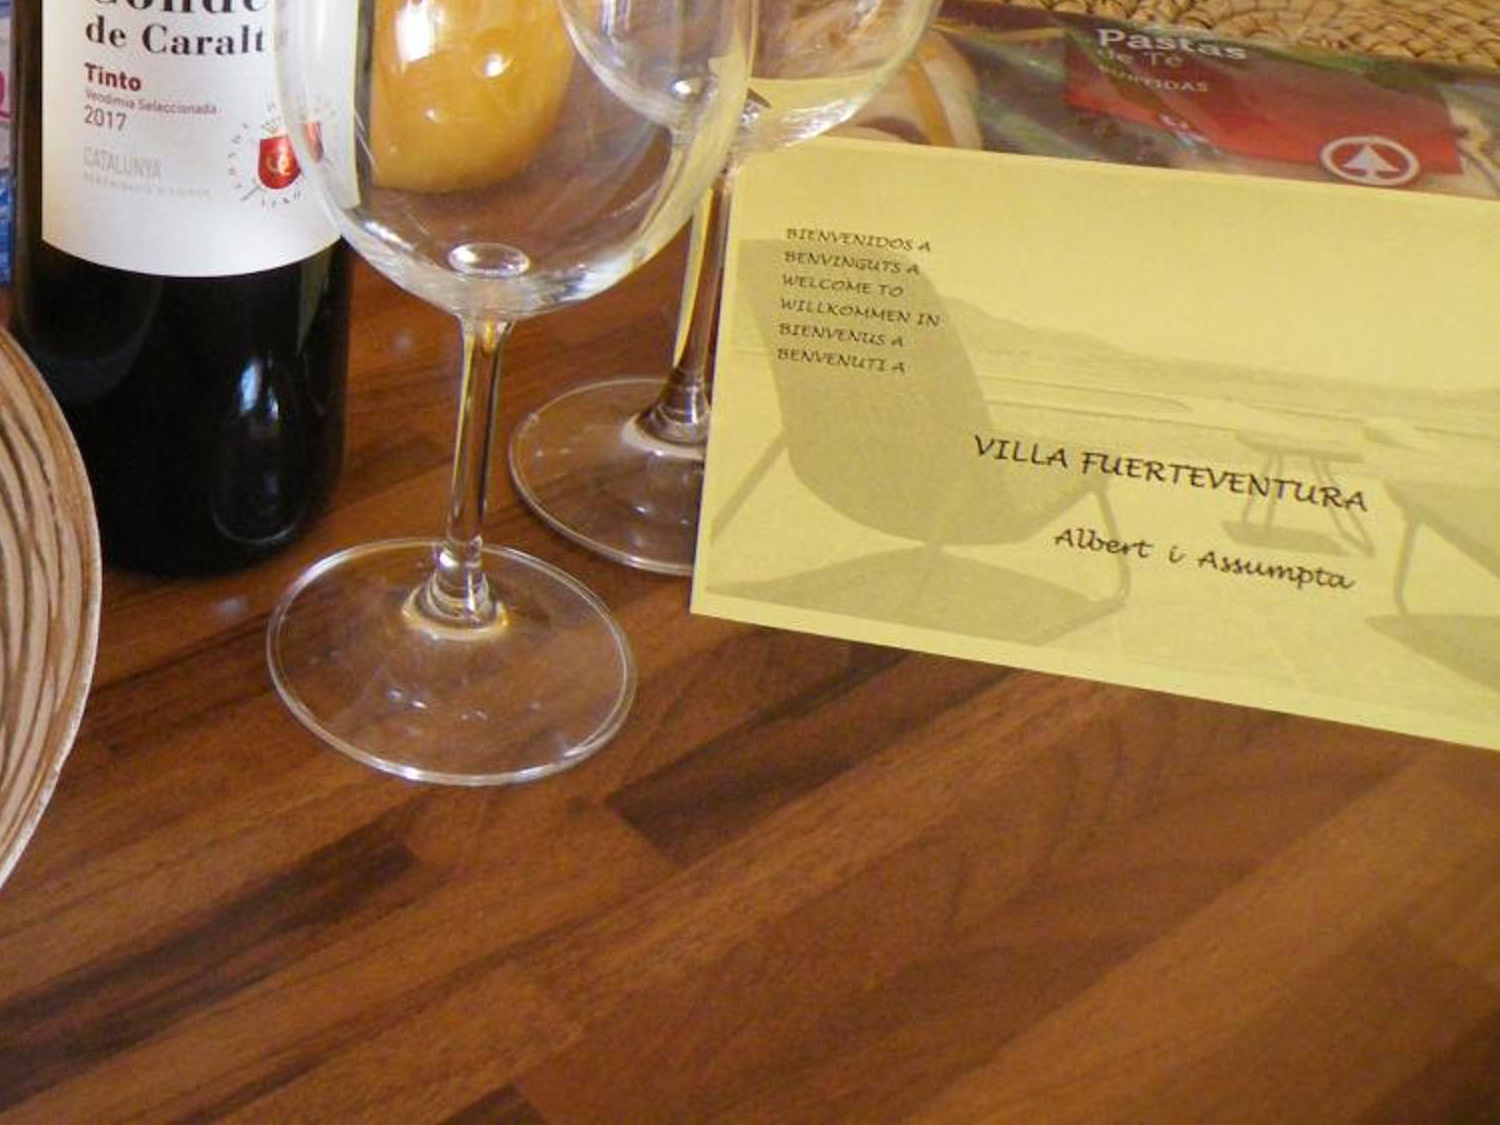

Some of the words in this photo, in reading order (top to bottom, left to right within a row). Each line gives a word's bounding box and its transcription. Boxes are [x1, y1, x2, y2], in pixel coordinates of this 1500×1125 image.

[85, 14, 127, 48] de
[141, 22, 266, 56] Caralt
[1096, 27, 1248, 61] Pastas
[84, 62, 143, 92] Tinto
[83, 104, 128, 132] 2017
[785, 227, 915, 252] BIENVENIDOS
[918, 239, 932, 252] A
[783, 249, 901, 274] BENVINGUTS
[906, 262, 921, 276] A
[781, 272, 874, 296] WELCOME
[878, 283, 905, 299] TO
[779, 296, 912, 324] WILLKOMMEN
[915, 311, 941, 328] IN
[778, 322, 886, 347] BIENVENUS
[890, 334, 905, 349] A
[776, 347, 888, 373] BENVENUTI
[890, 359, 906, 374] A
[974, 434, 1069, 469] VILLA
[1081, 451, 1368, 513] FUERTEVENTURA
[1053, 527, 1153, 558] Albert
[1168, 545, 1186, 564] i
[1197, 550, 1357, 591] Assumpta
